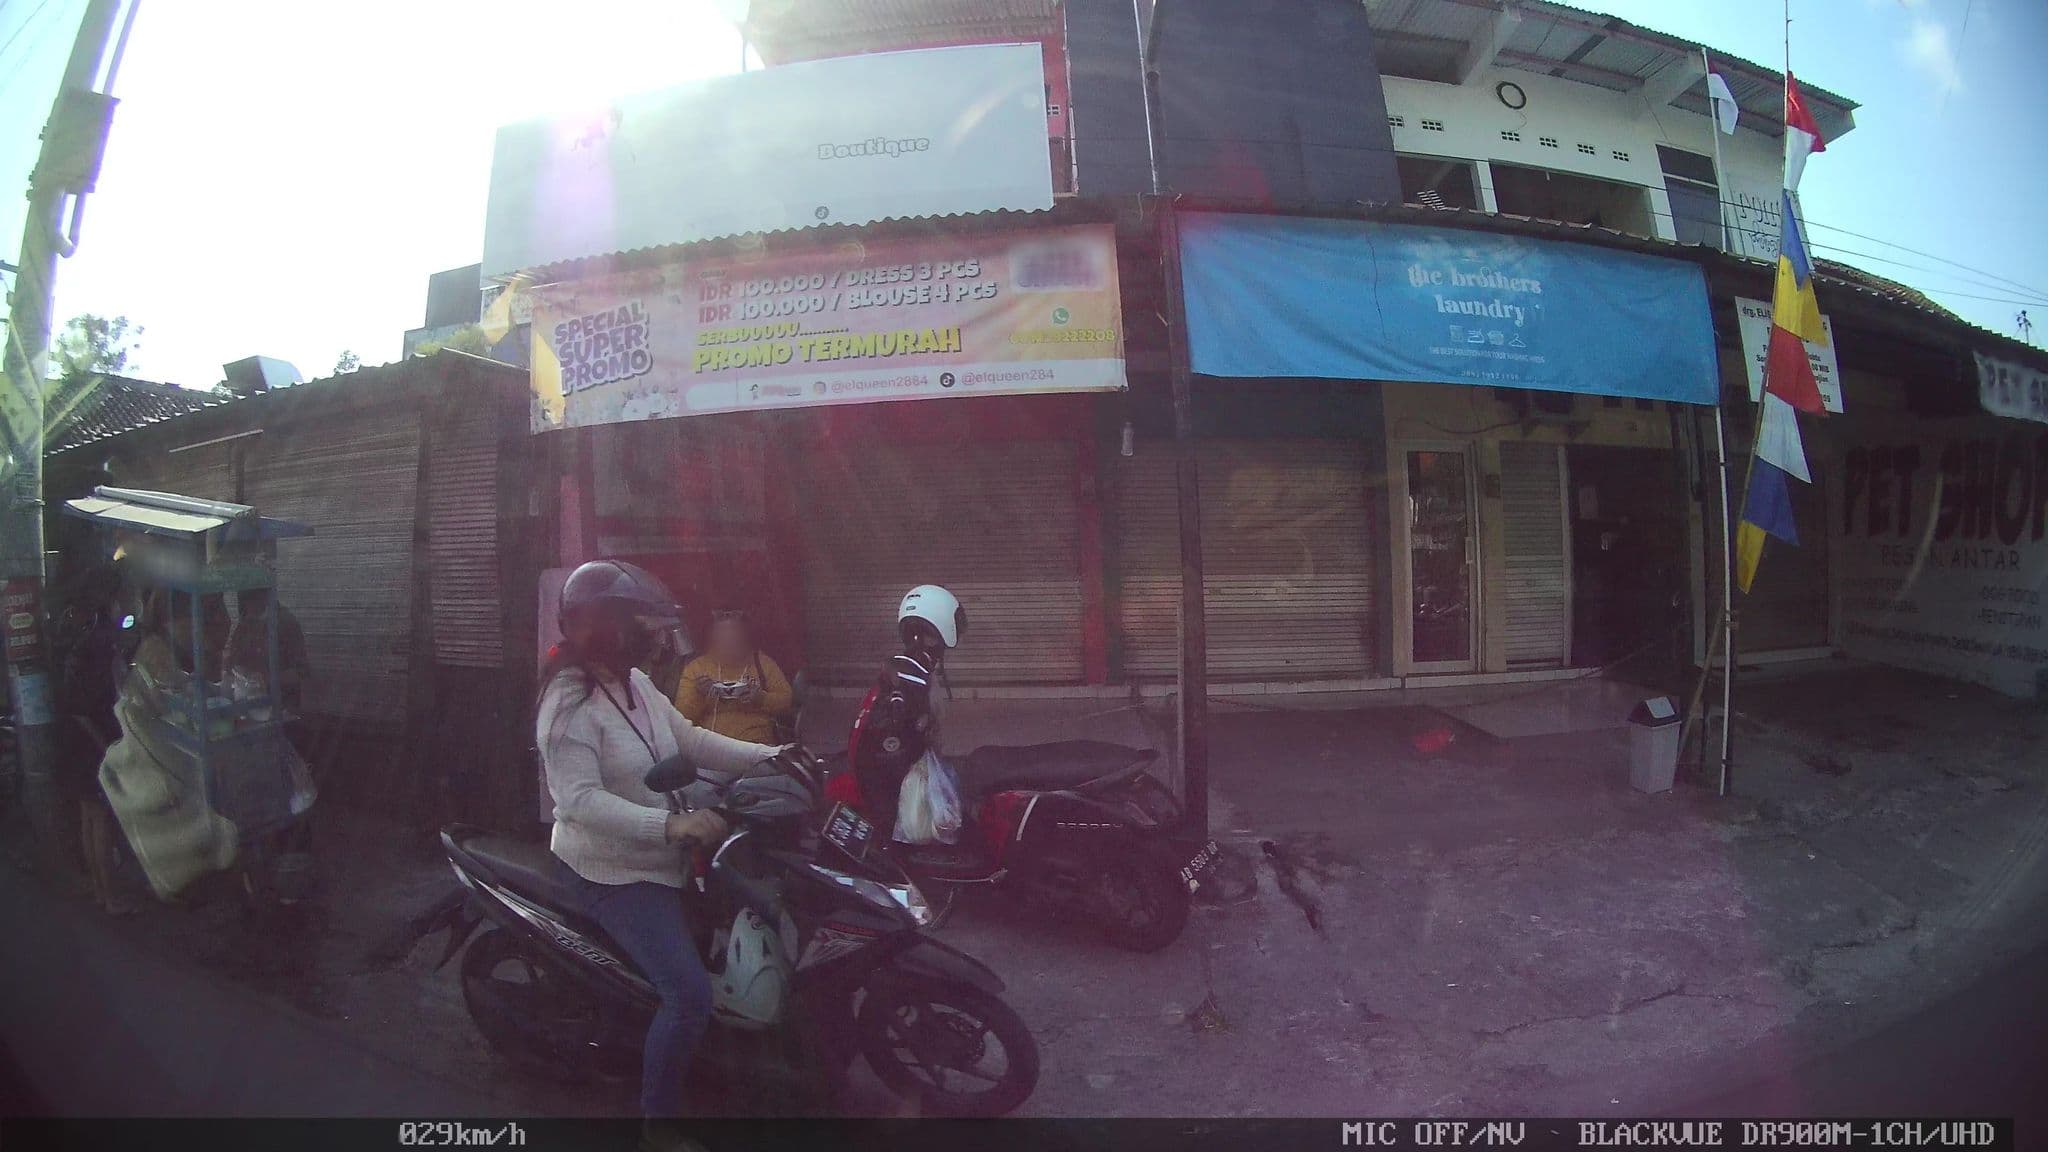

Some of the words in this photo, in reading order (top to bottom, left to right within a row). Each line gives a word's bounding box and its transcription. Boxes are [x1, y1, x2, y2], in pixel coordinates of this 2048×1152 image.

[818, 137, 930, 160] Boutique
[700, 282, 733, 302] IDR
[740, 272, 826, 298] 100.000
[847, 264, 915, 287] DRESS
[919, 261, 934, 281] 3
[938, 259, 981, 280] PCS
[1408, 263, 1444, 288] the
[1451, 266, 1543, 295] brothers
[554, 299, 645, 344] SPECIAL
[698, 303, 733, 324] IDR
[740, 294, 826, 321] 100.000
[848, 284, 931, 310] BLOUSE
[934, 282, 951, 303] 4
[956, 281, 998, 301] PCS
[1433, 293, 1526, 328] laundry
[556, 323, 645, 368] SUPER
[693, 342, 794, 375] PROMO
[798, 327, 962, 364] TERMURAH
[560, 348, 650, 394] PROMO
[831, 375, 929, 392] @elqueen2884
[961, 369, 1055, 386] @elqueen284
[1845, 446, 1921, 537] PET
[1880, 546, 1945, 570] PESN
[1950, 550, 2021, 571] ANTAR
